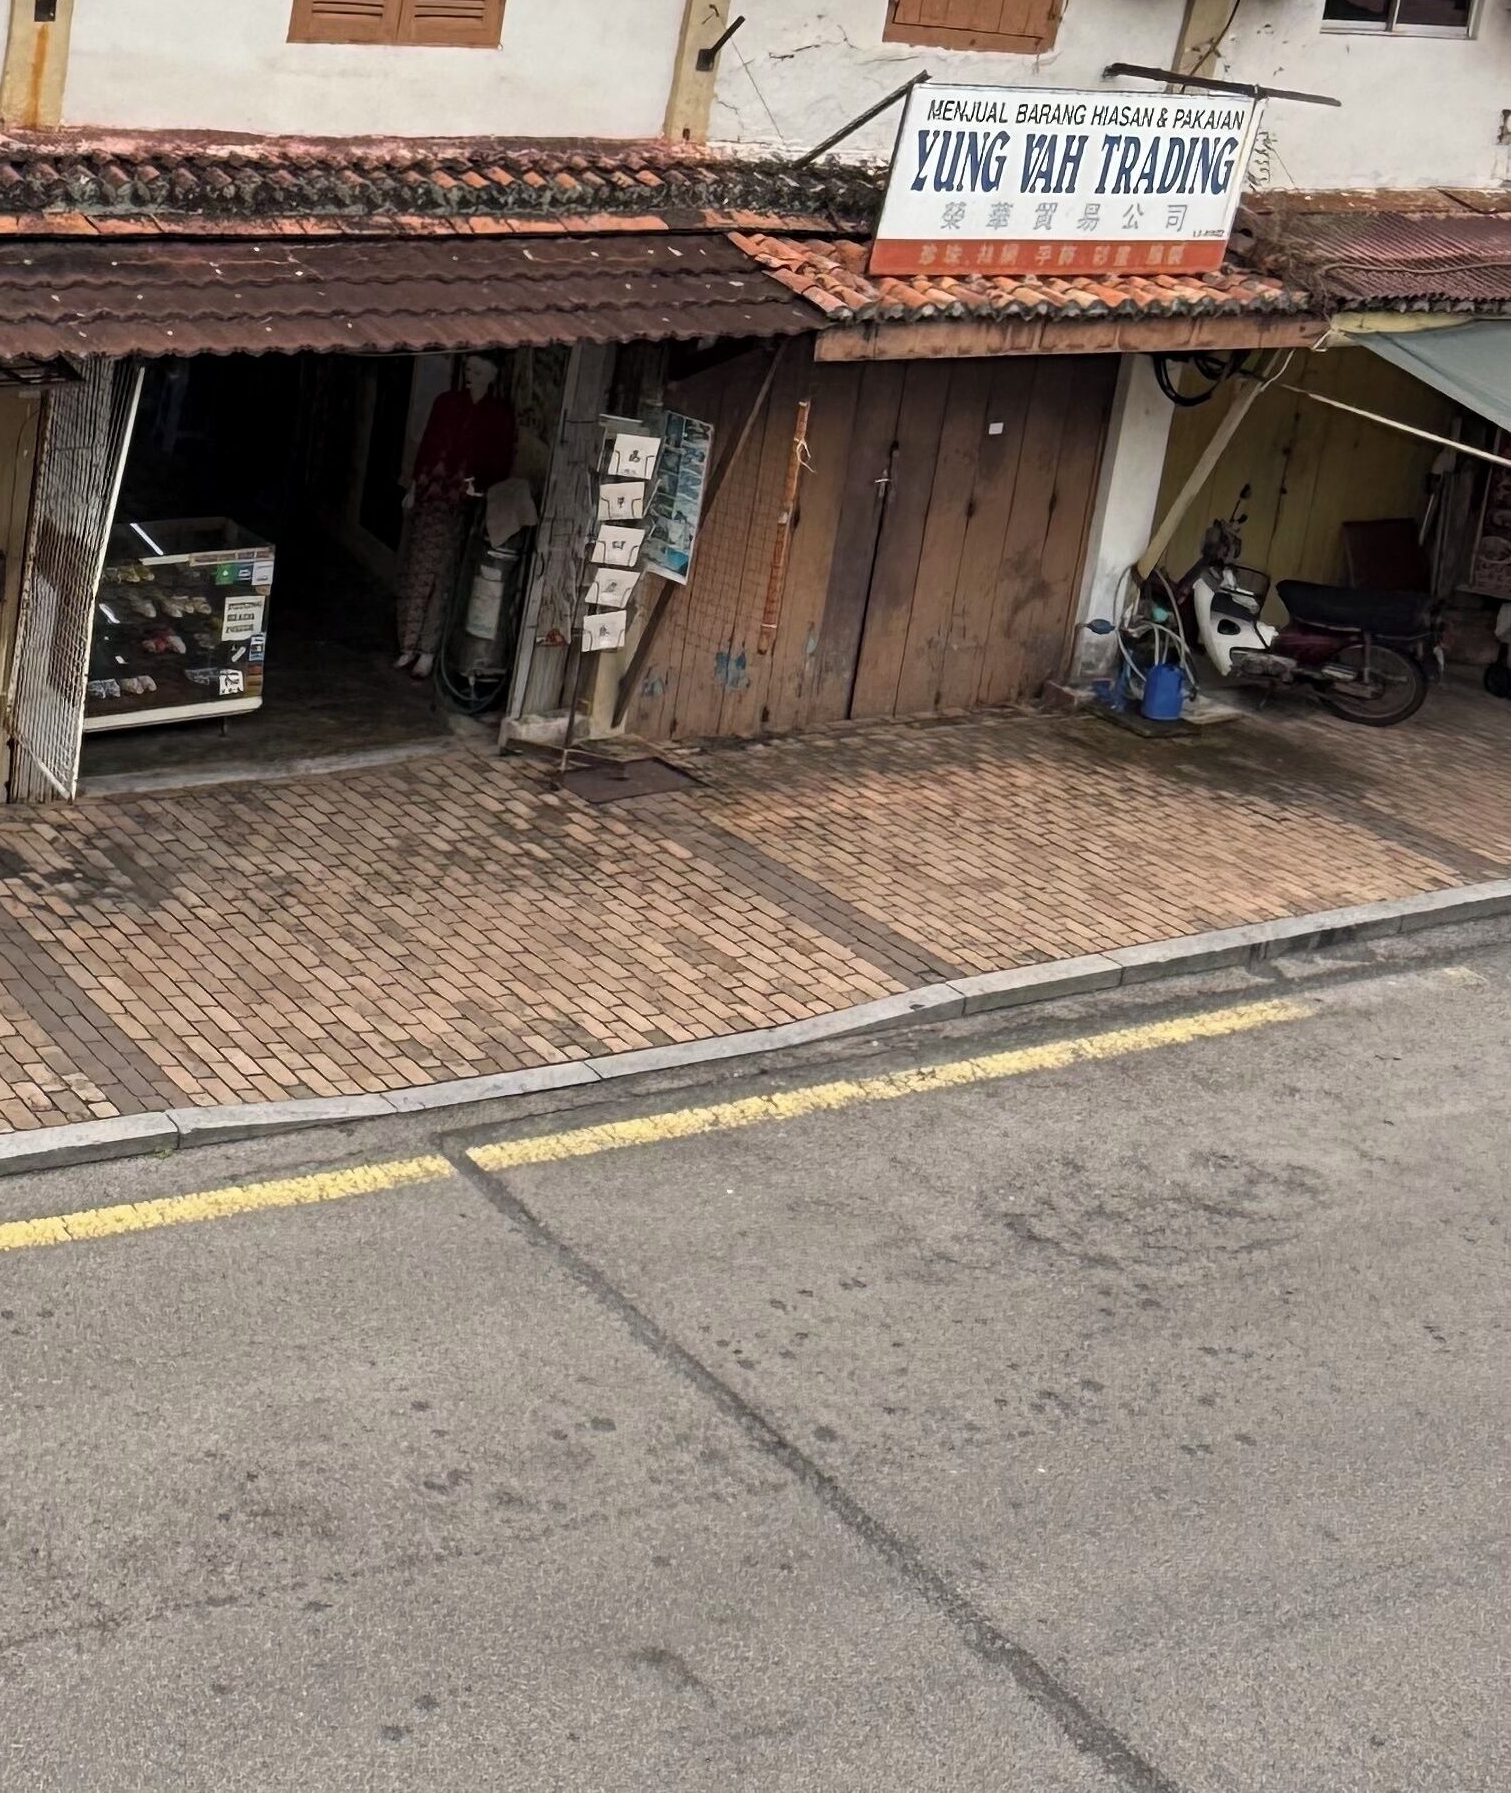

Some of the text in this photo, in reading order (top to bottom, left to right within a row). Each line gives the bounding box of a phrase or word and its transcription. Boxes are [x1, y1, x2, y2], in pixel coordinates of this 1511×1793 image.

[927, 99, 1245, 131] MENJUAL BARANG HIASAN & PAKAIAN
[910, 129, 1011, 192] YUNG
[1094, 133, 1239, 195] TRADING
